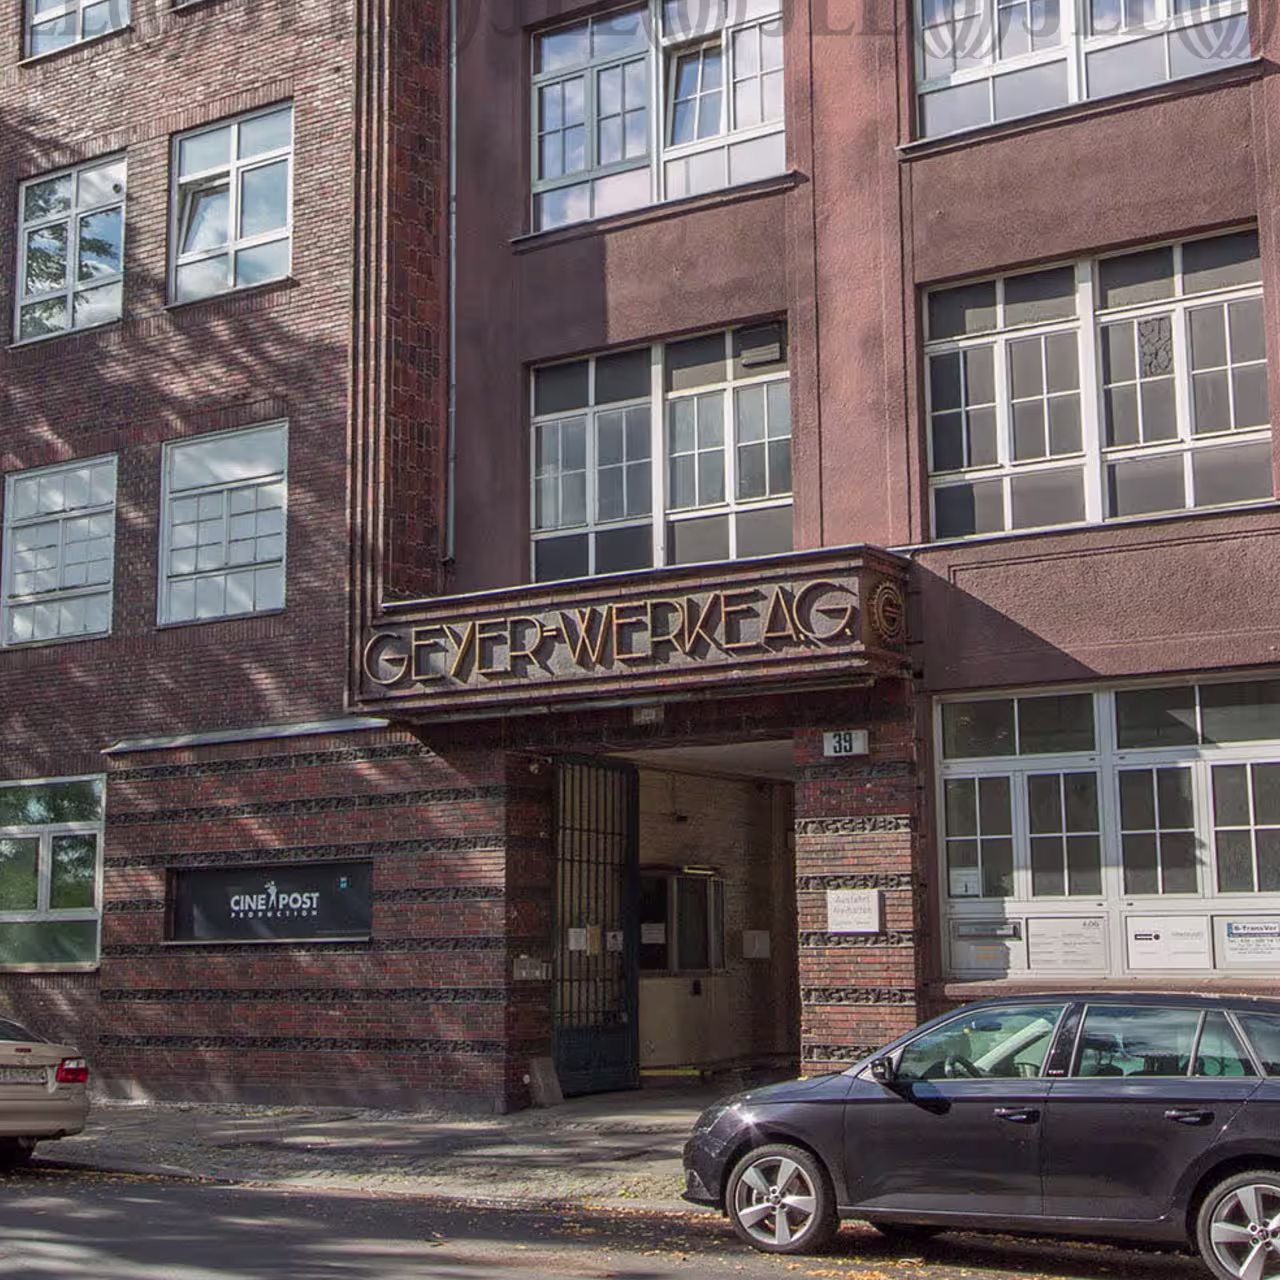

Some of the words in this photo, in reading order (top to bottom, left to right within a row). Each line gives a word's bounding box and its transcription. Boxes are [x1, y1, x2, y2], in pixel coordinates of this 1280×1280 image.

[832, 732, 853, 754] 39
[230, 894, 267, 911] CINE
[279, 892, 320, 909] POST
[230, 910, 318, 919] PRODUCTION
